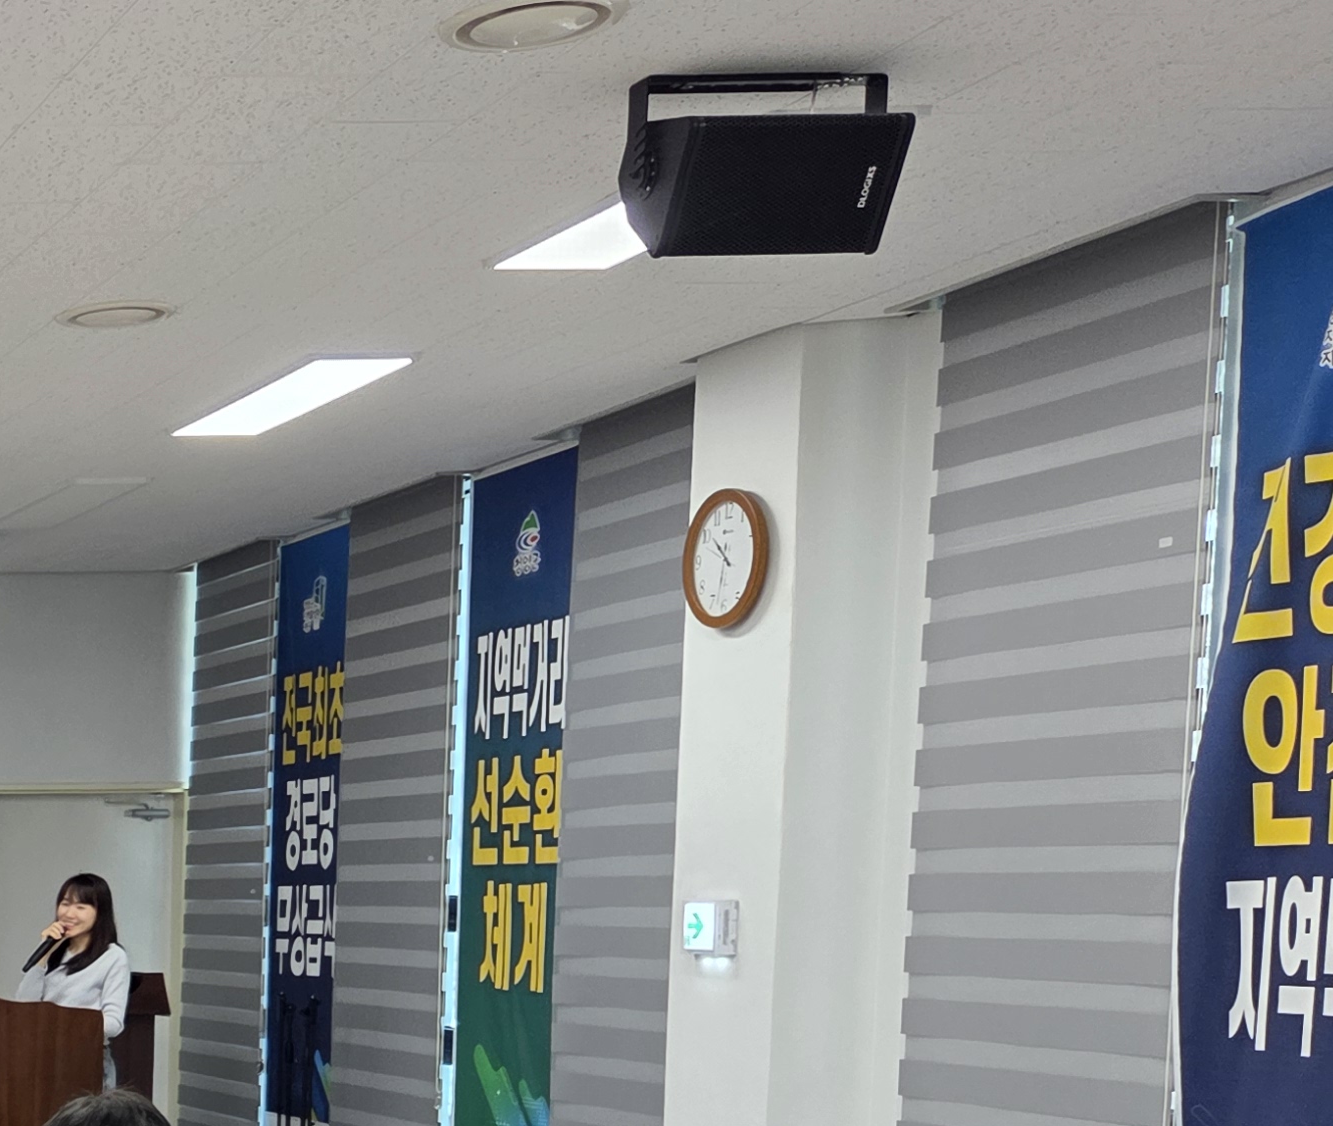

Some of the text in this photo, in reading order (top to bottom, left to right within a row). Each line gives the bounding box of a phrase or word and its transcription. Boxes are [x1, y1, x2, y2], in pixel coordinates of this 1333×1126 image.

[282, 661, 345, 765] 전국최초
[474, 615, 570, 739] 지역먹거리
[471, 748, 563, 866] 선순환
[1242, 664, 1333, 848] 안
[285, 774, 337, 872] 경로당
[479, 879, 549, 994] 체계
[1225, 874, 1333, 1058] 지역
